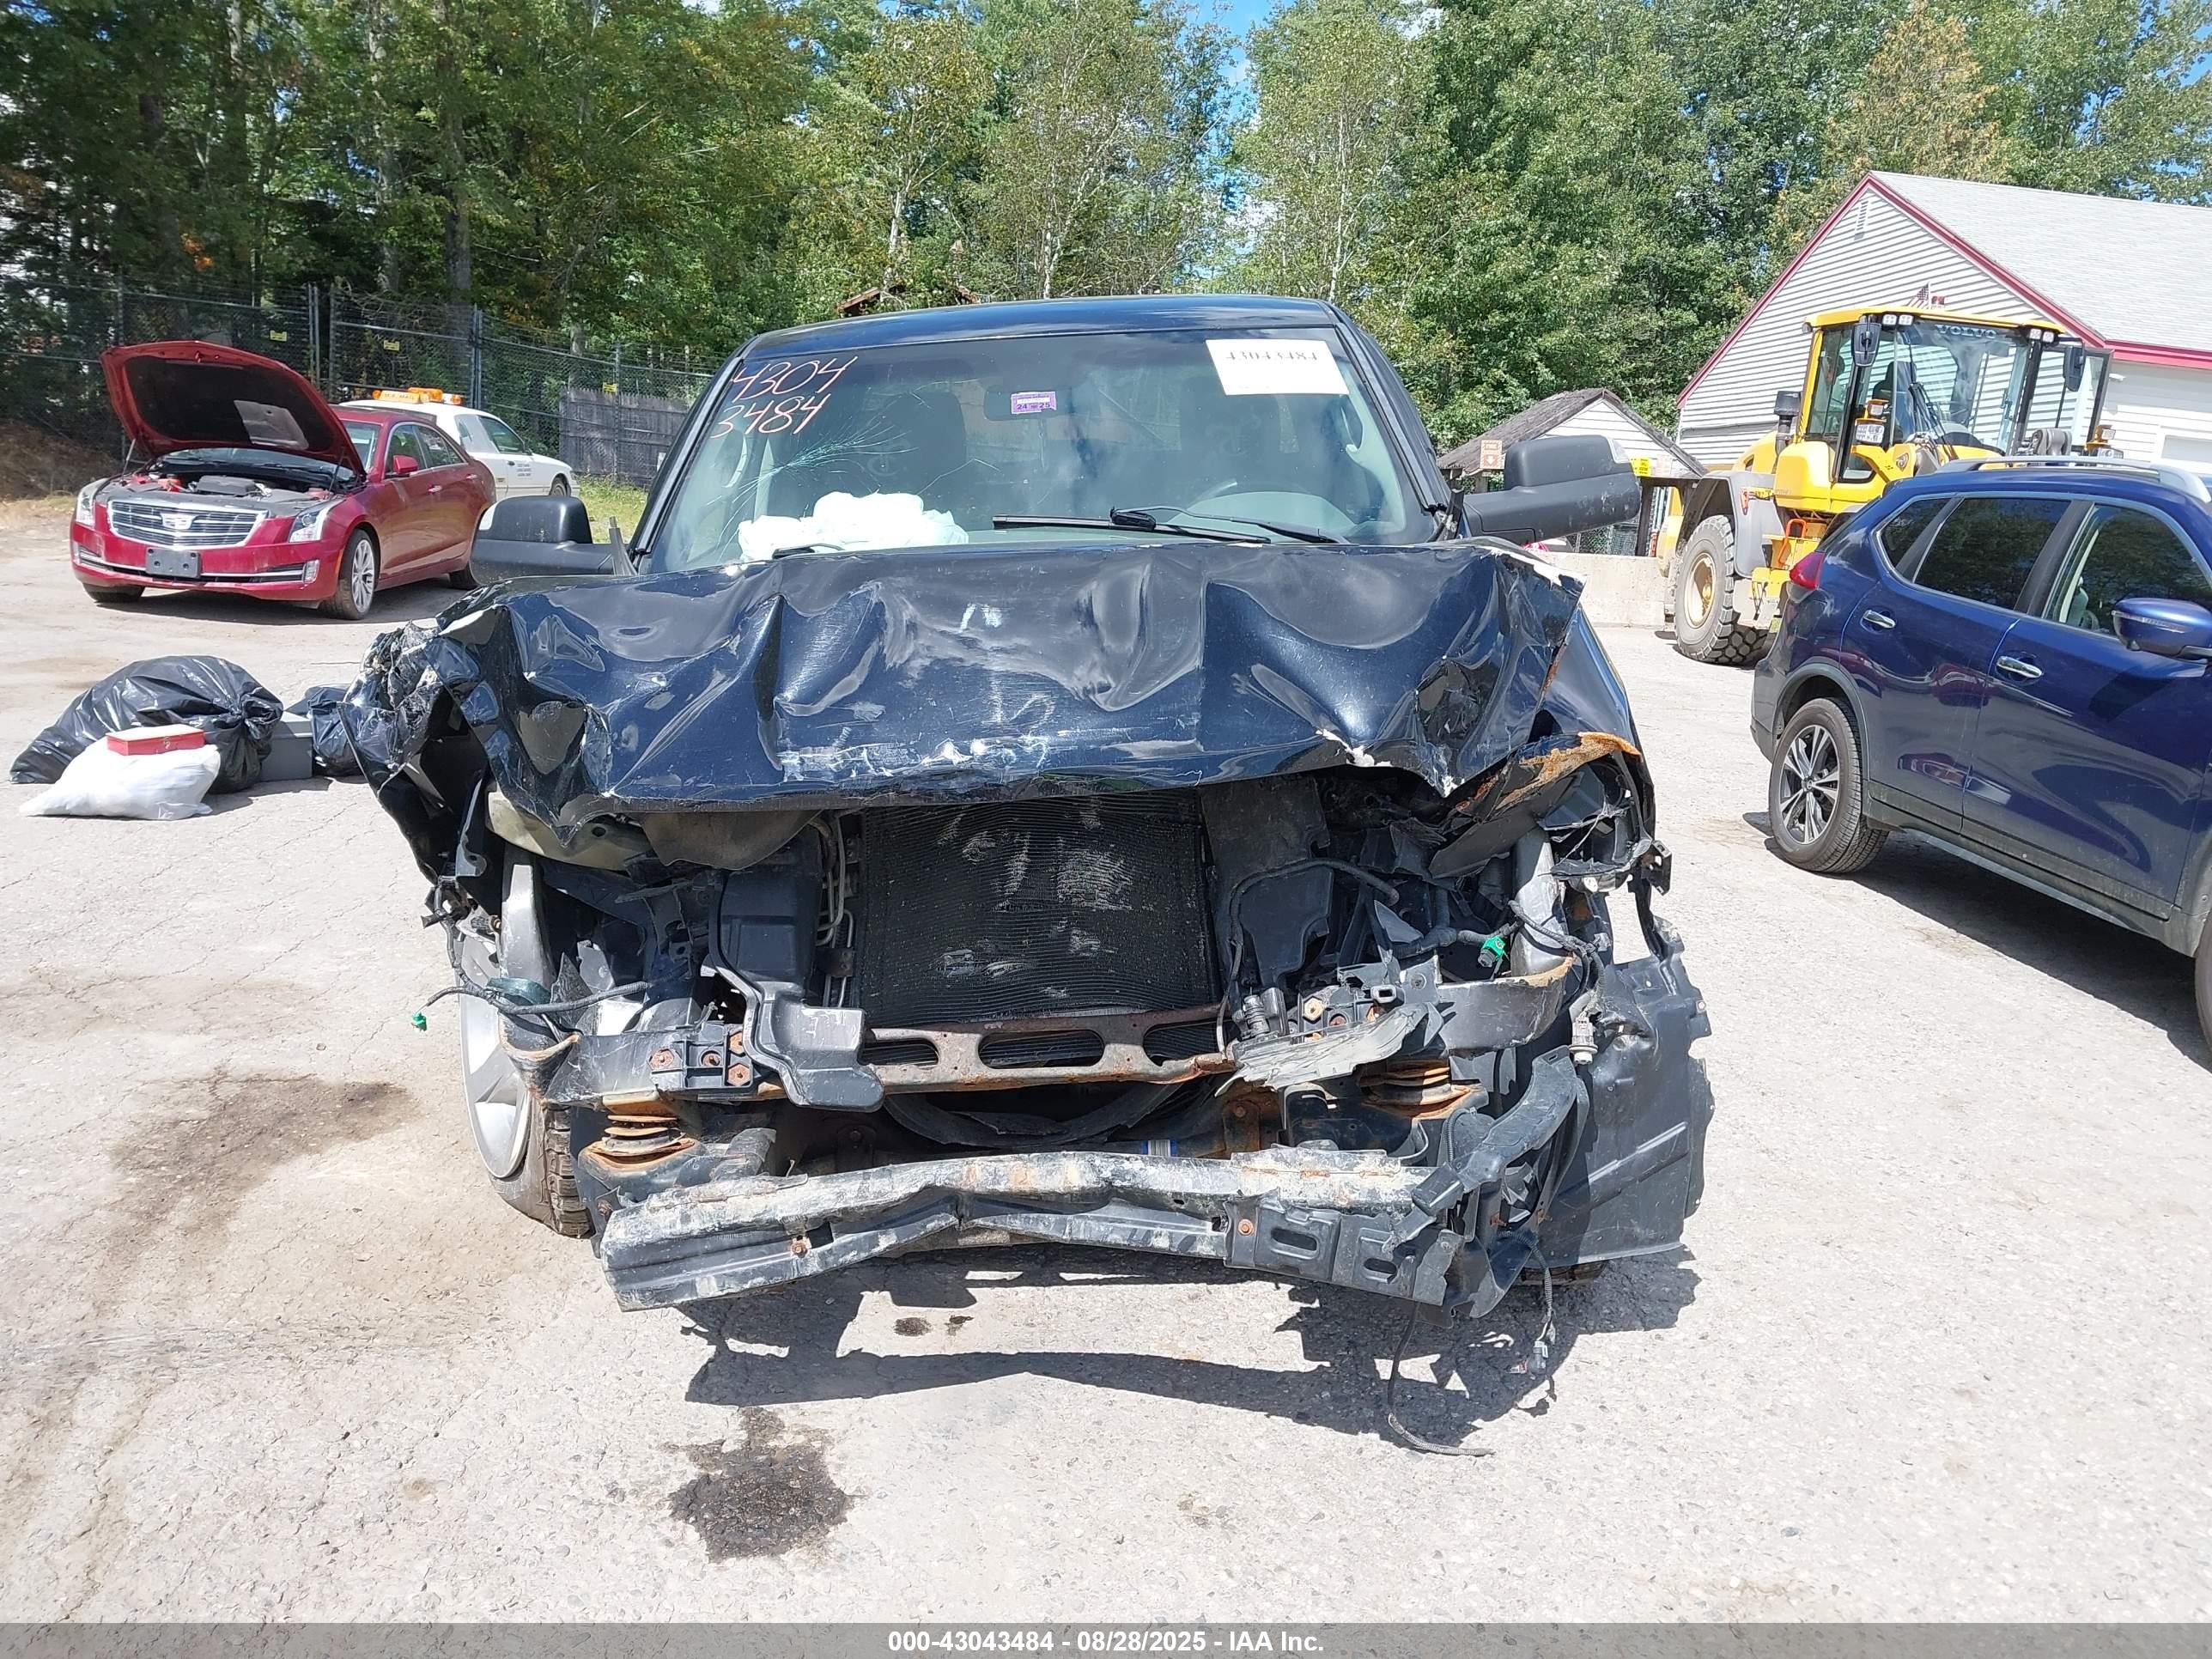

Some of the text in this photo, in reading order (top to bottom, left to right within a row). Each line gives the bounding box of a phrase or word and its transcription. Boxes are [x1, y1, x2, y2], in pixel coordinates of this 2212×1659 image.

[1935, 325, 1996, 339] VOLVO
[731, 356, 859, 404] 4304
[709, 393, 831, 439] 3484
